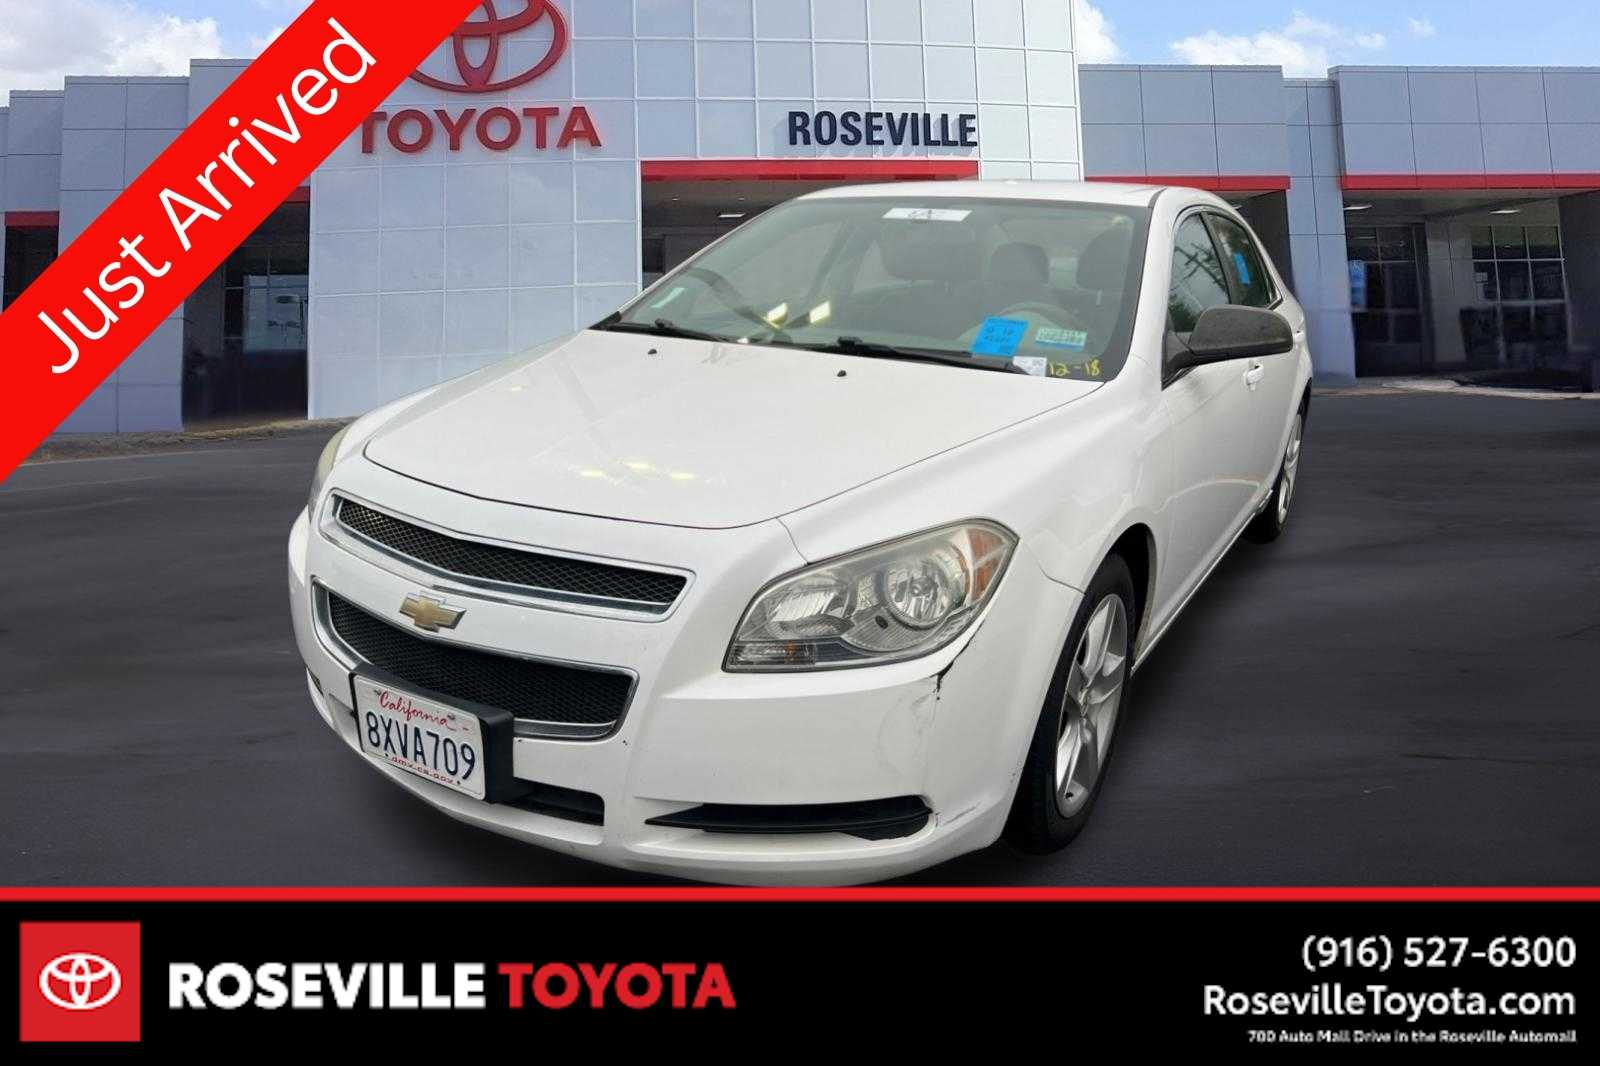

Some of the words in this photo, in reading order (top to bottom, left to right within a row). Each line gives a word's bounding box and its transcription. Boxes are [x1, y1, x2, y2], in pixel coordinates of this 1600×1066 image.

[361, 106, 602, 154] TOYOTA
[788, 110, 978, 147] ROSEVILLE
[380, 687, 457, 731] California
[366, 711, 476, 780] 8XVA709
